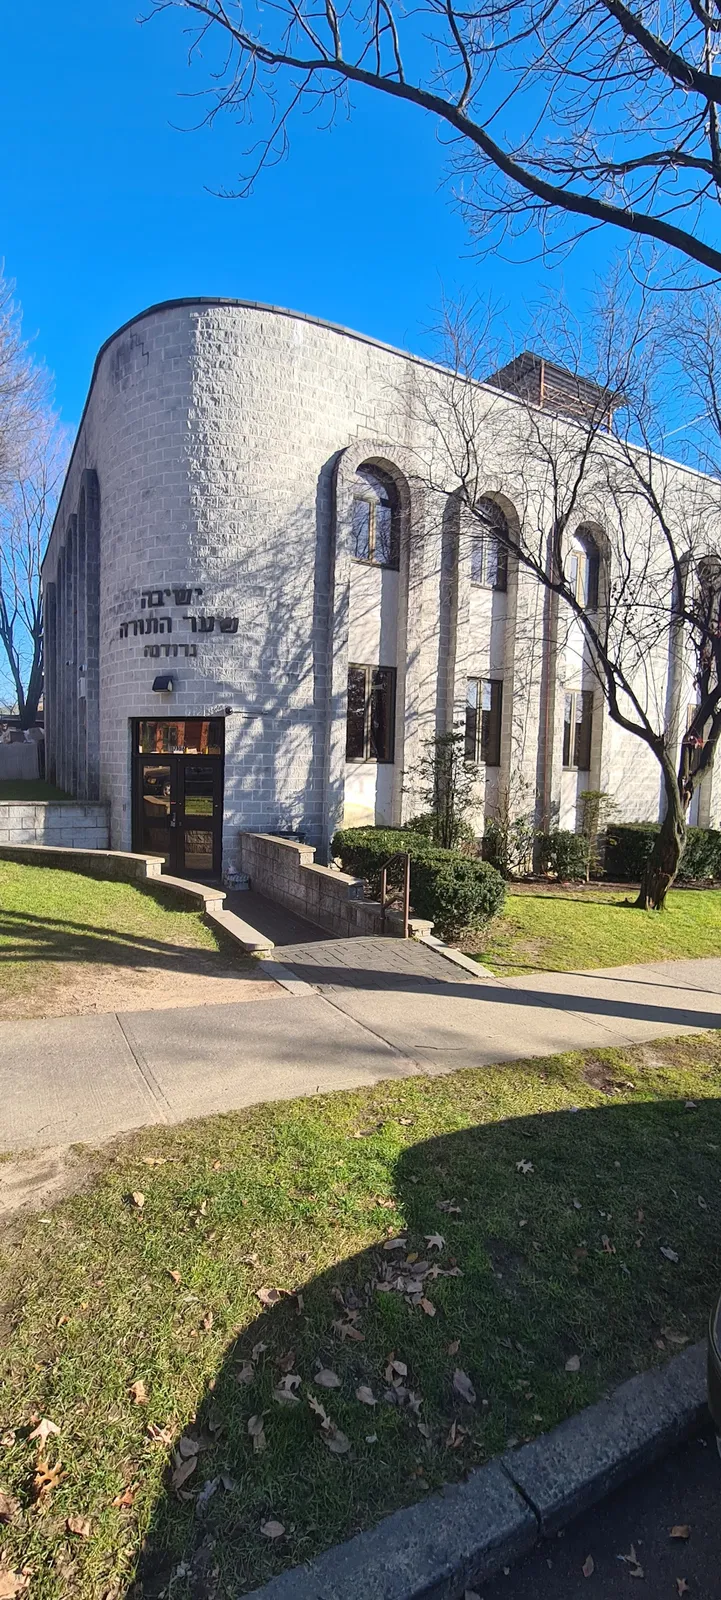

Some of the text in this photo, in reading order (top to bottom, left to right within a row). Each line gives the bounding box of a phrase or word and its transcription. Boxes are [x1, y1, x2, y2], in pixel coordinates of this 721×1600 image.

[141, 588, 203, 609] ישיבה
[119, 616, 240, 638] שער התורה
